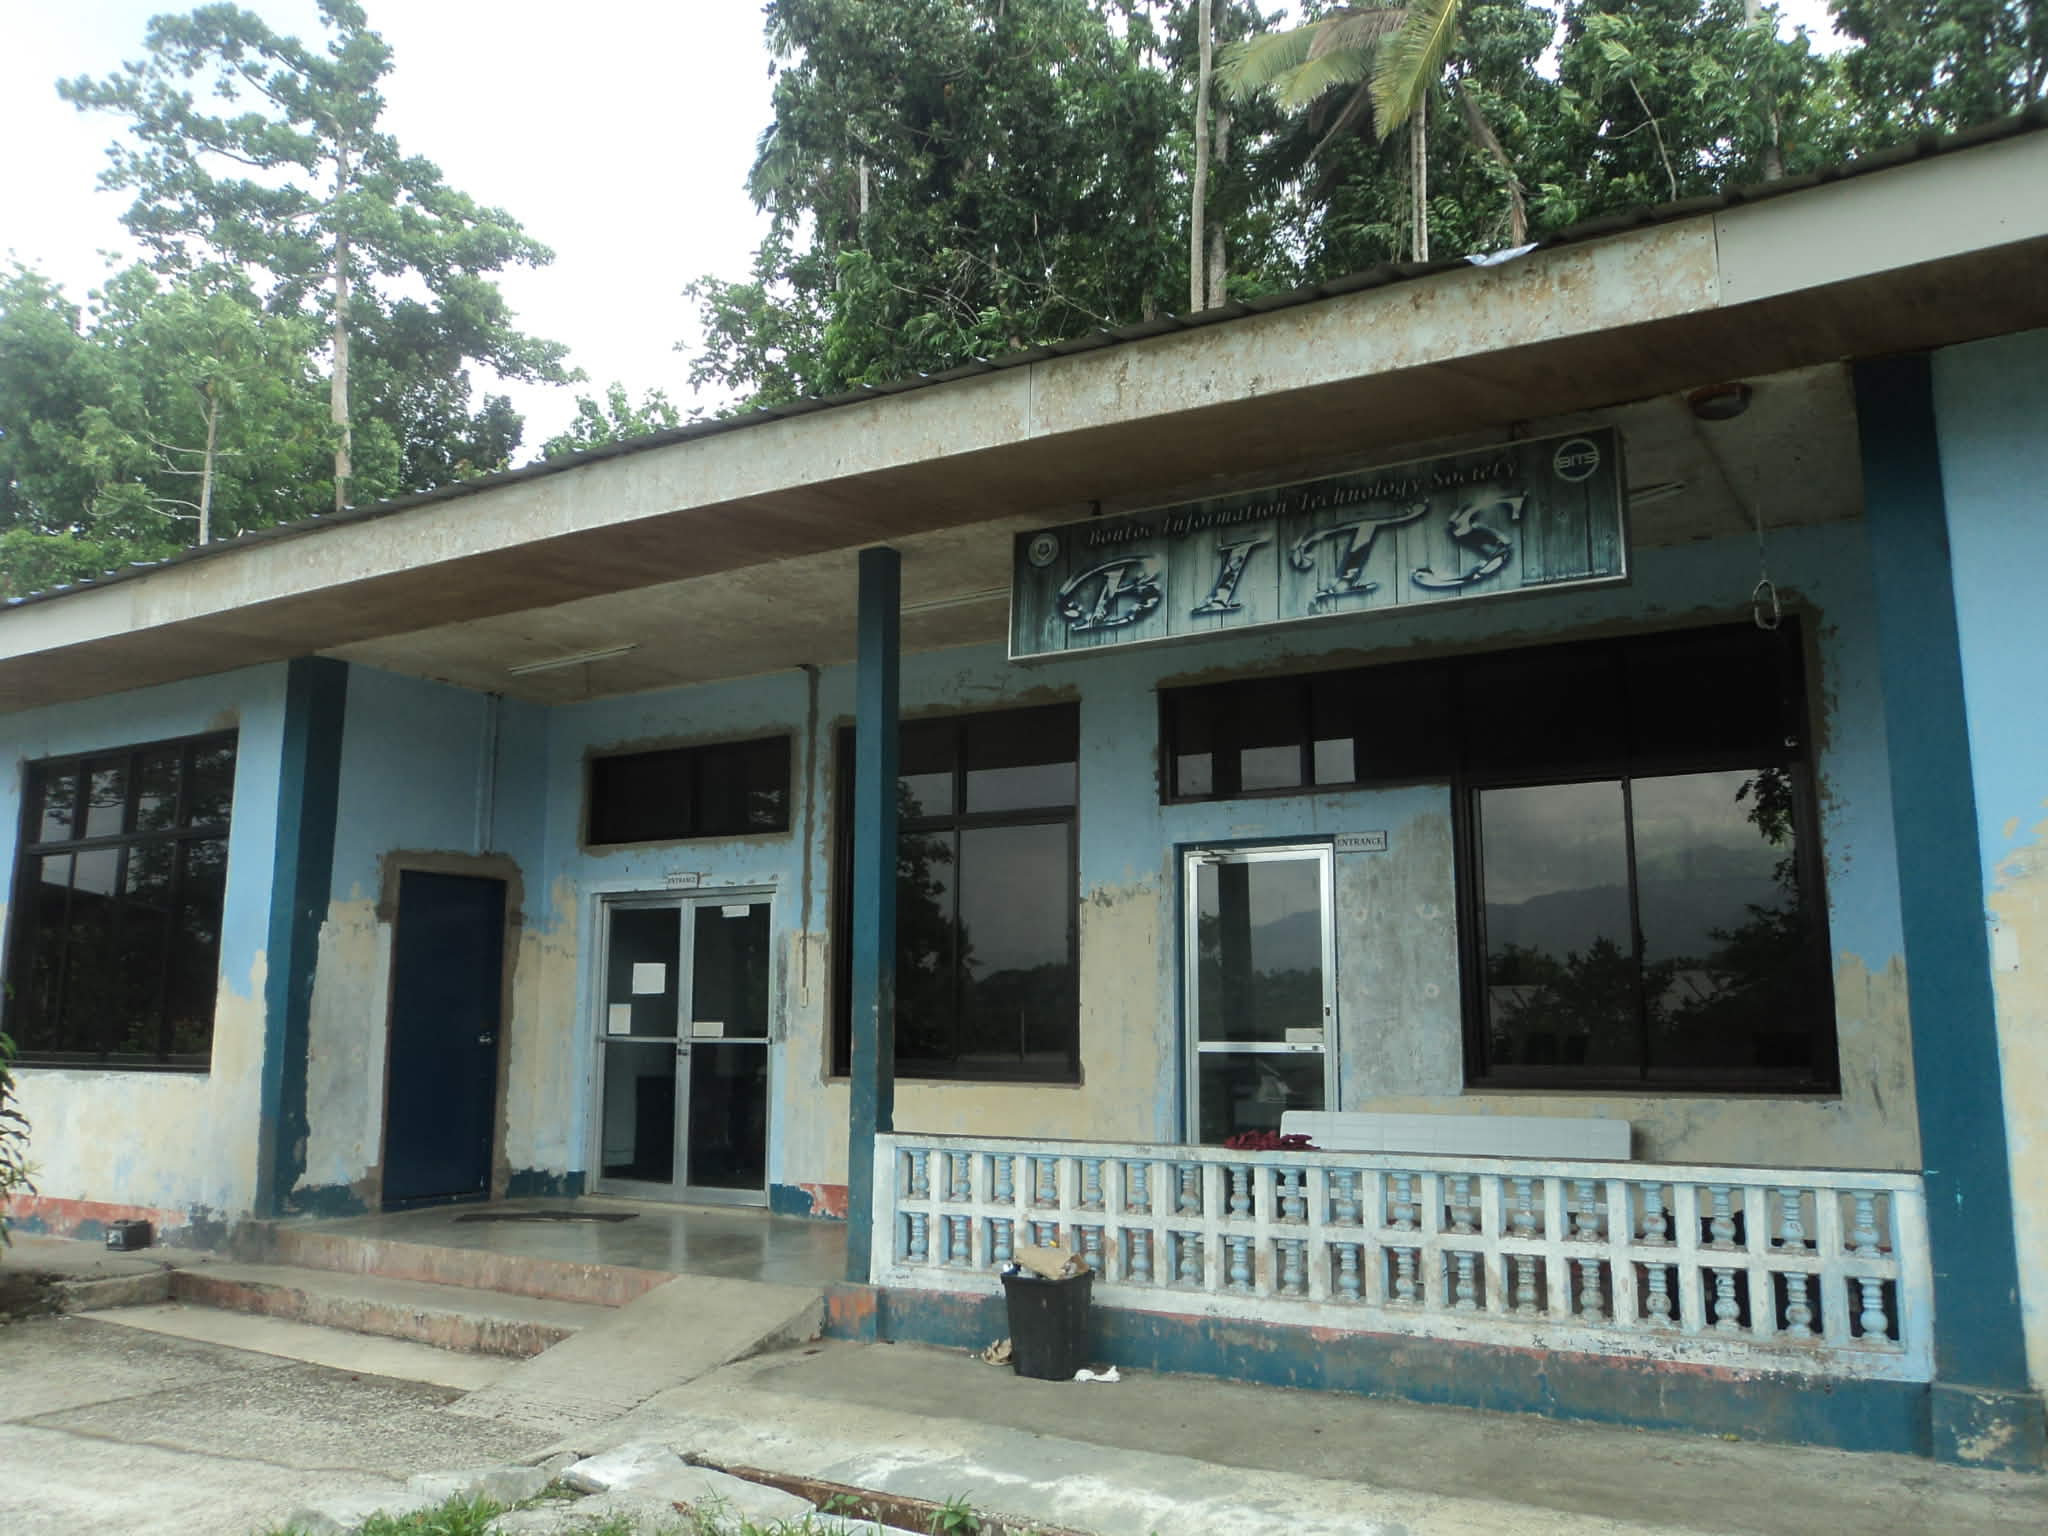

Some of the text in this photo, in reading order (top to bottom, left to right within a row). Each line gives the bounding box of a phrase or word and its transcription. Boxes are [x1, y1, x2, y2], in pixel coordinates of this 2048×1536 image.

[1557, 452, 1600, 469] BITS
[1162, 503, 1287, 535] Information
[1297, 477, 1421, 511] Technology
[1432, 460, 1519, 486] Society
[1058, 488, 1528, 632] BITS
[1337, 837, 1384, 848] ENTRANCE
[665, 876, 697, 885] ENTRANCE
